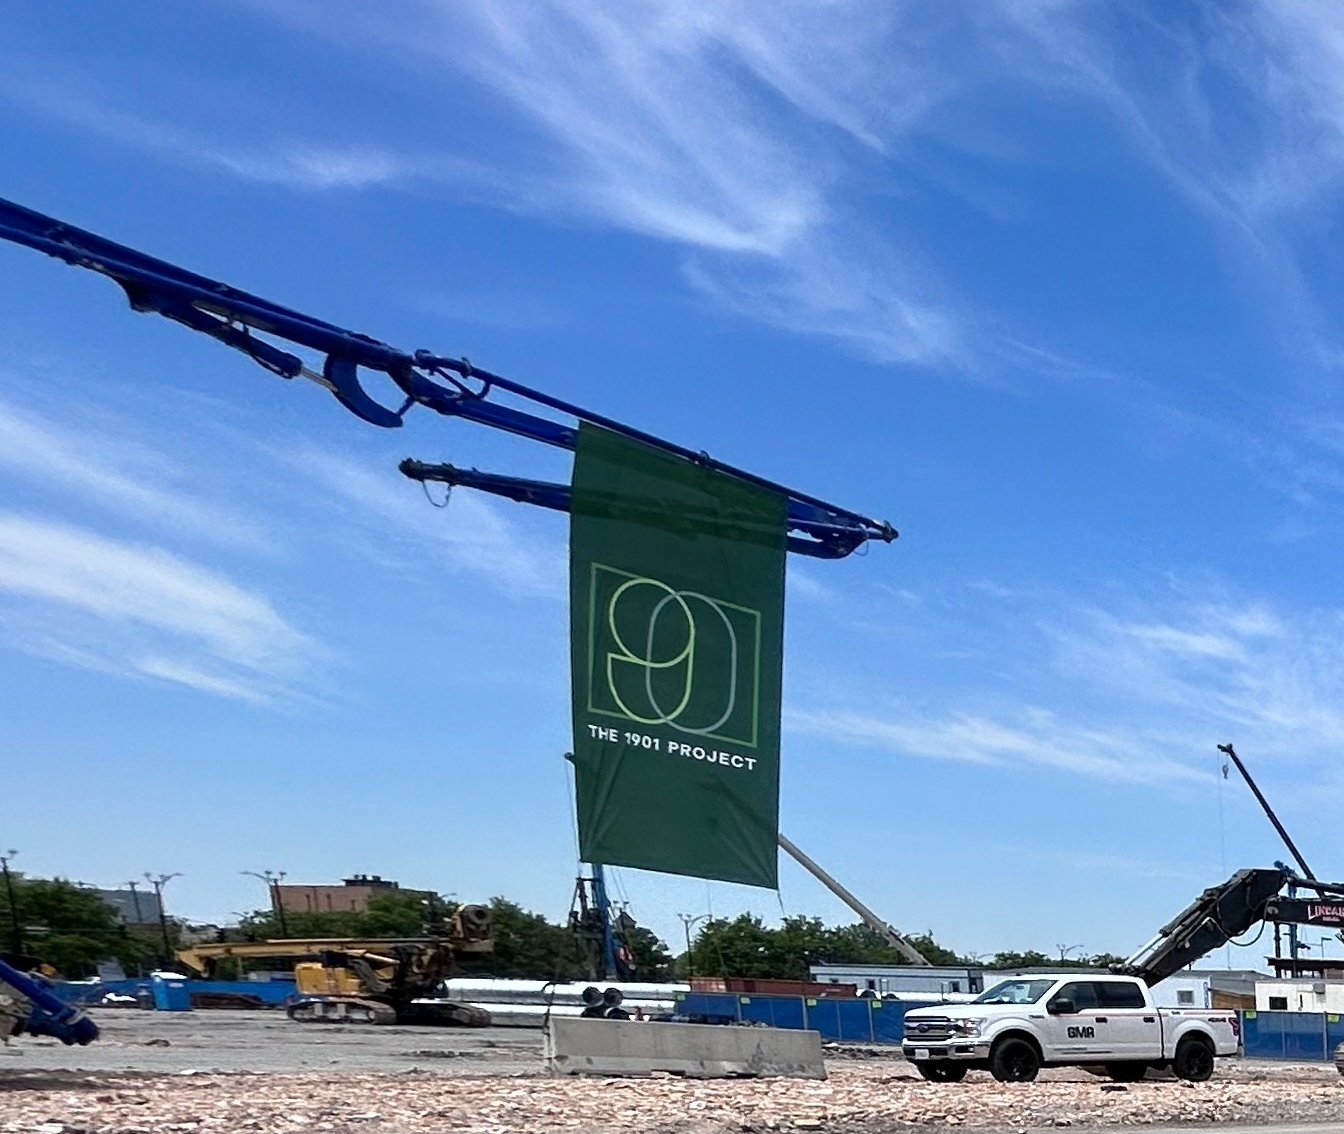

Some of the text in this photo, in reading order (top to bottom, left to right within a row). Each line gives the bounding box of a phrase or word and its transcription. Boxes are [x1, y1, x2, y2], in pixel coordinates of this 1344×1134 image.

[588, 724, 757, 770] THE 1901 PROJECT
